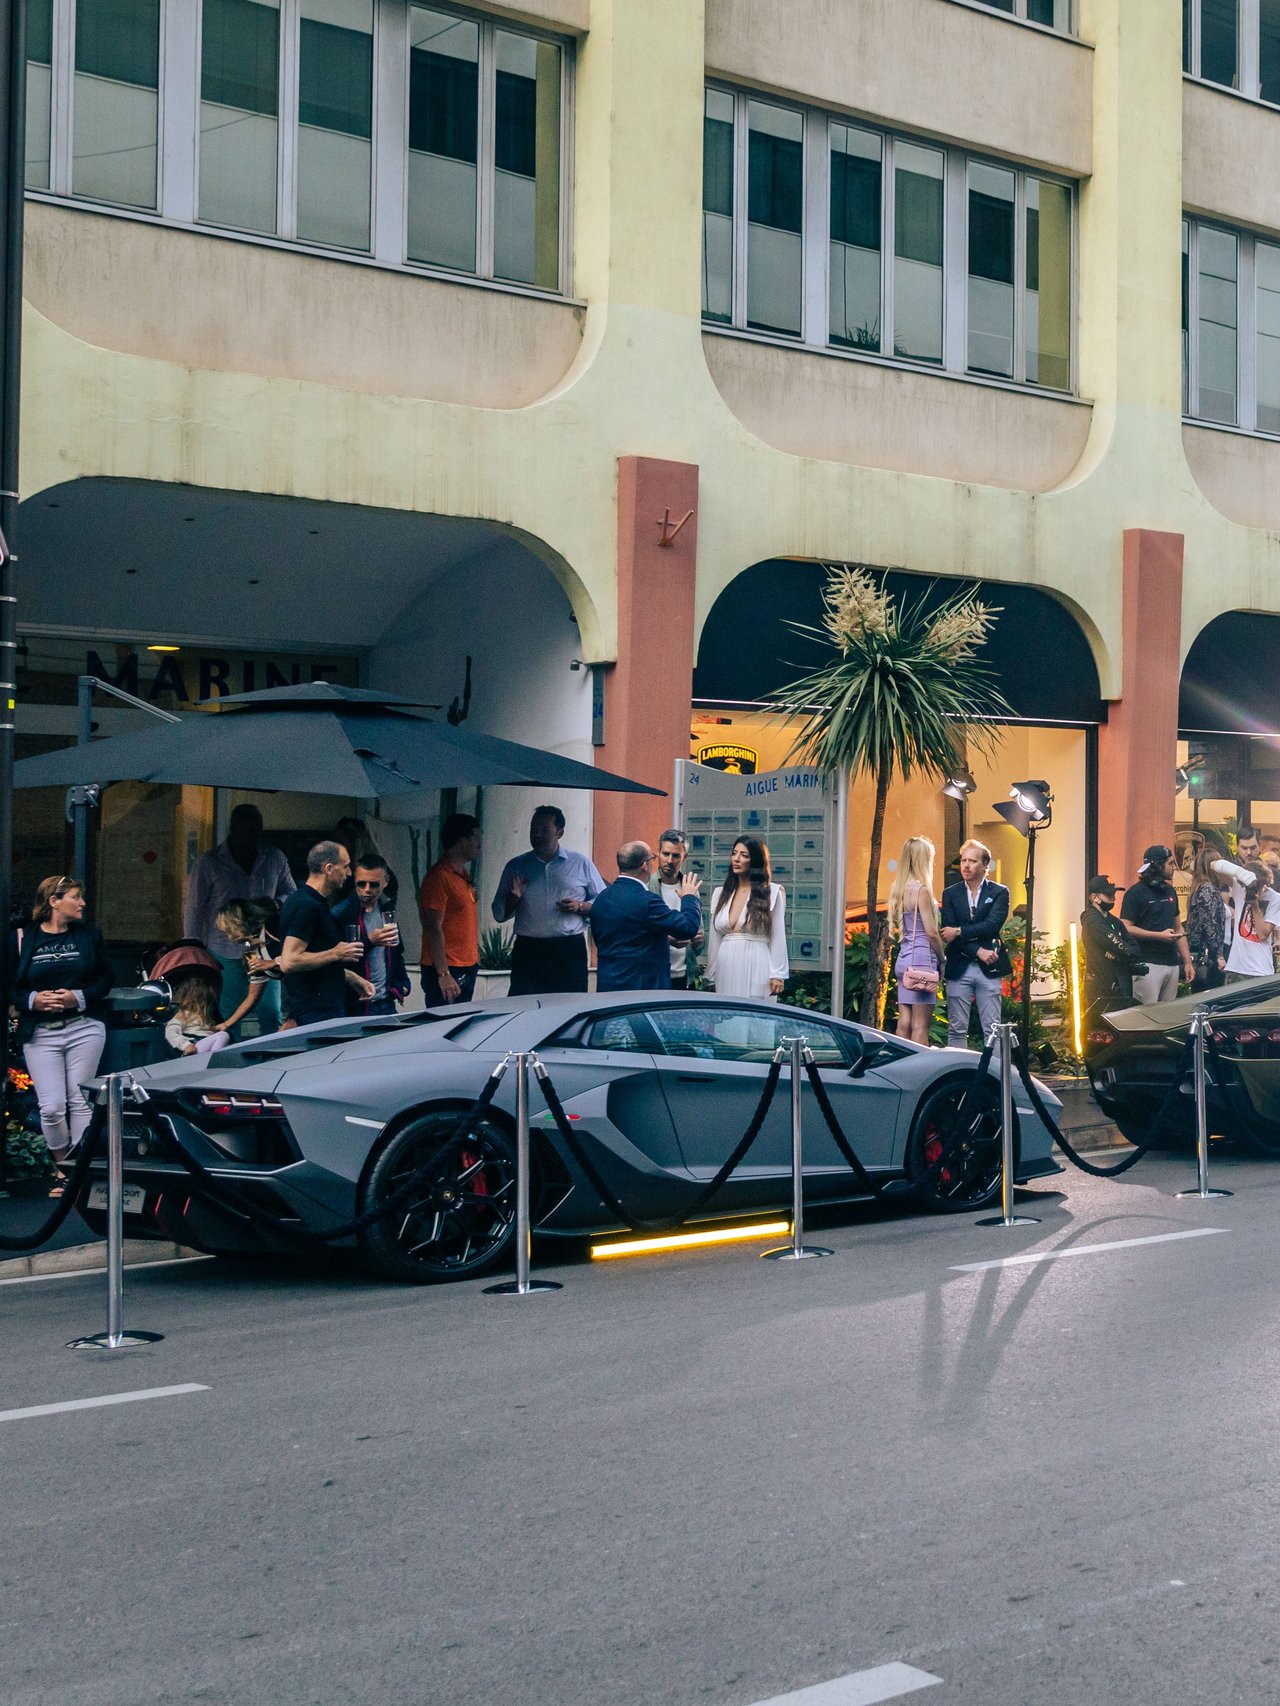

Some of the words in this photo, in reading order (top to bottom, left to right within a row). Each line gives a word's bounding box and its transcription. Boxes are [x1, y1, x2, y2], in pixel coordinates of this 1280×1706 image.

[702, 746, 755, 763] LAMBORGHINI
[689, 773, 700, 785] 24
[745, 777, 779, 796] AIGUE
[785, 773, 828, 791] MARIN
